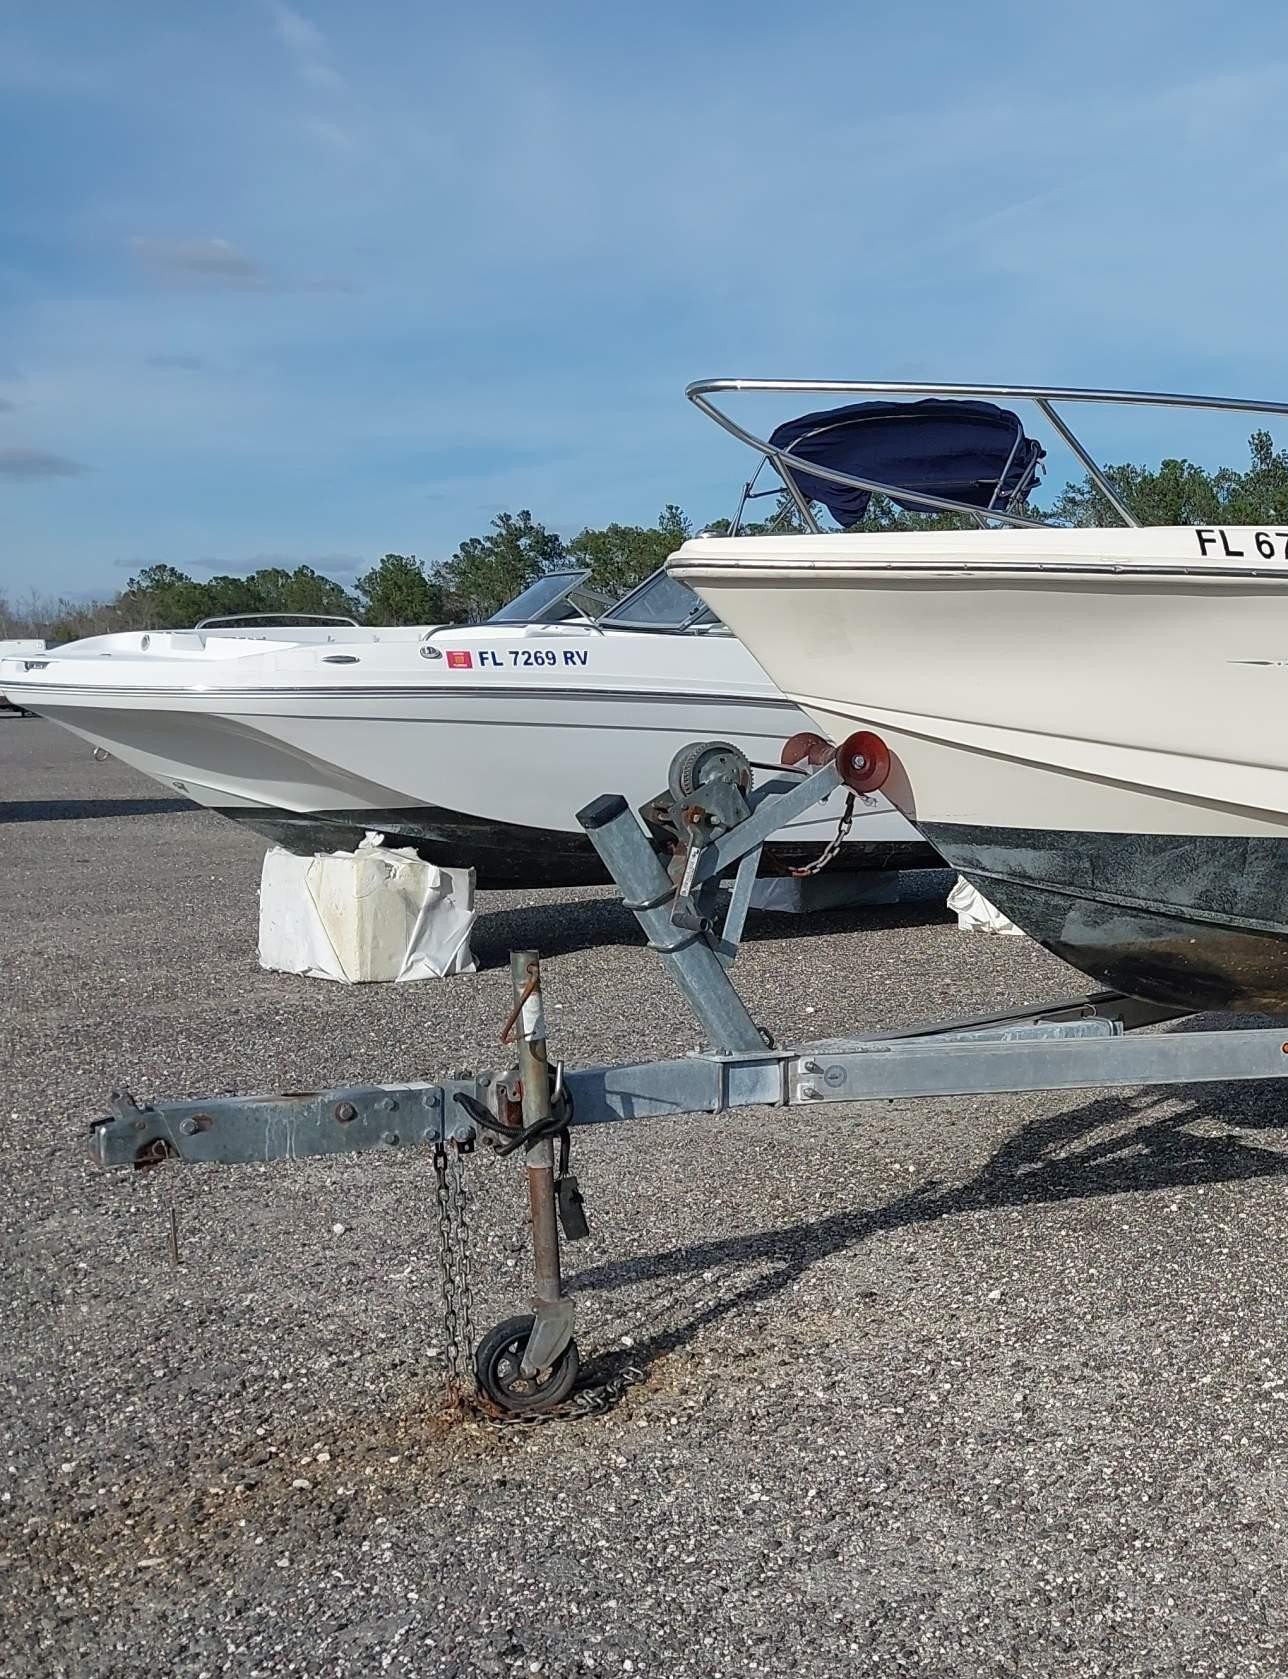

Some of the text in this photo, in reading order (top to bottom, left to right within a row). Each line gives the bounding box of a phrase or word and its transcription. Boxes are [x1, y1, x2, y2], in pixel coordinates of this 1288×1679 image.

[1195, 529, 1245, 557] FL
[478, 650, 589, 667] FL 7269 RV
